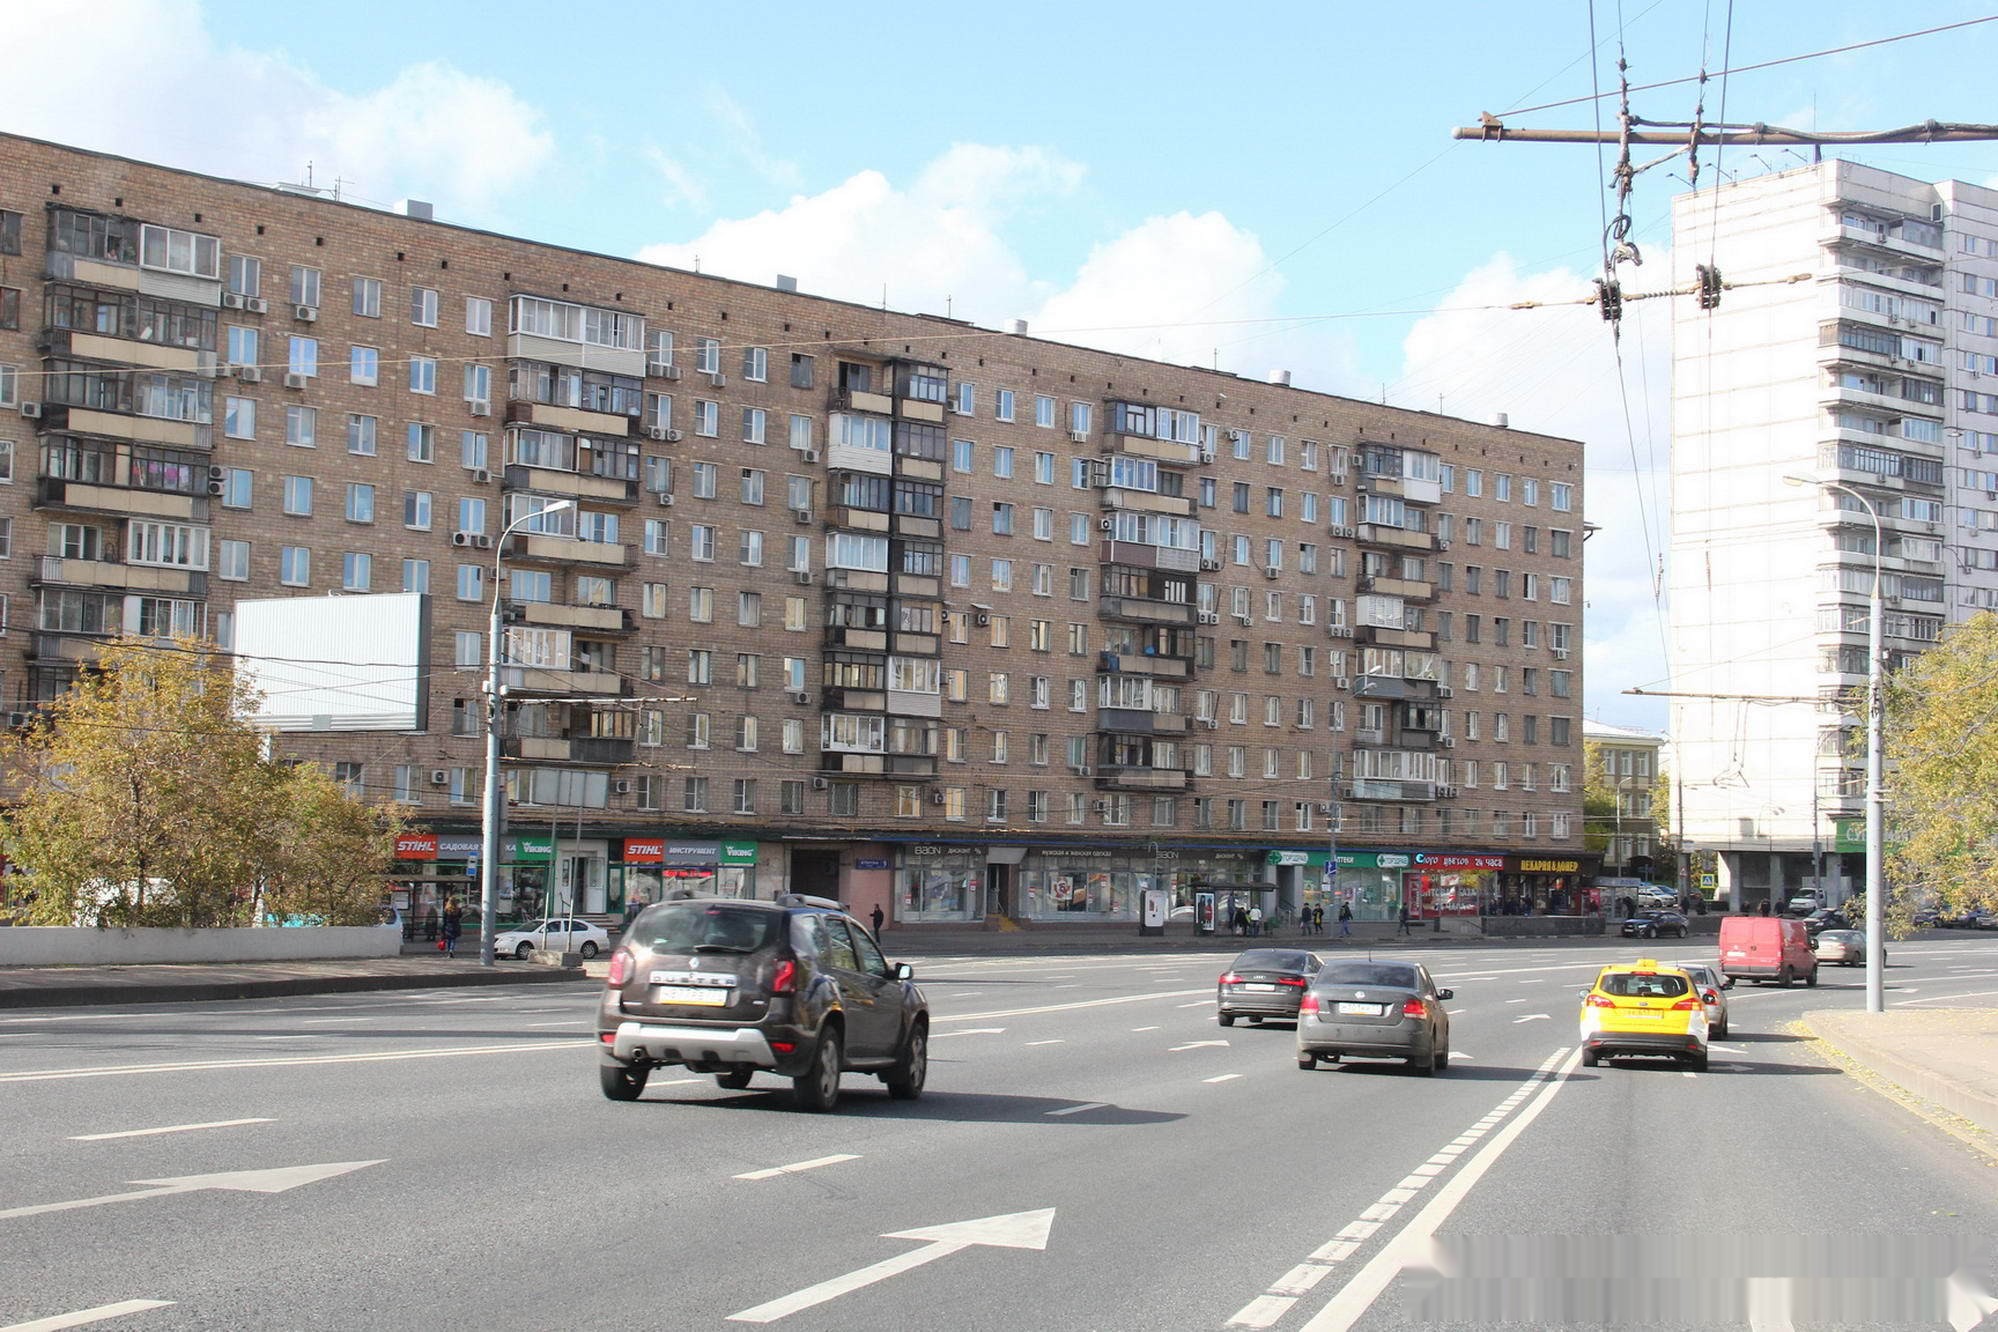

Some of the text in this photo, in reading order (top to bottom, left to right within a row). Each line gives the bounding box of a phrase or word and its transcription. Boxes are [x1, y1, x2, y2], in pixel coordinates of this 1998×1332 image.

[397, 841, 435, 851] STIHL
[440, 843, 479, 852] САДОВАЯ
[628, 845, 662, 855] STIHL
[726, 846, 753, 857] VIKING
[653, 976, 735, 985] DUSTER
